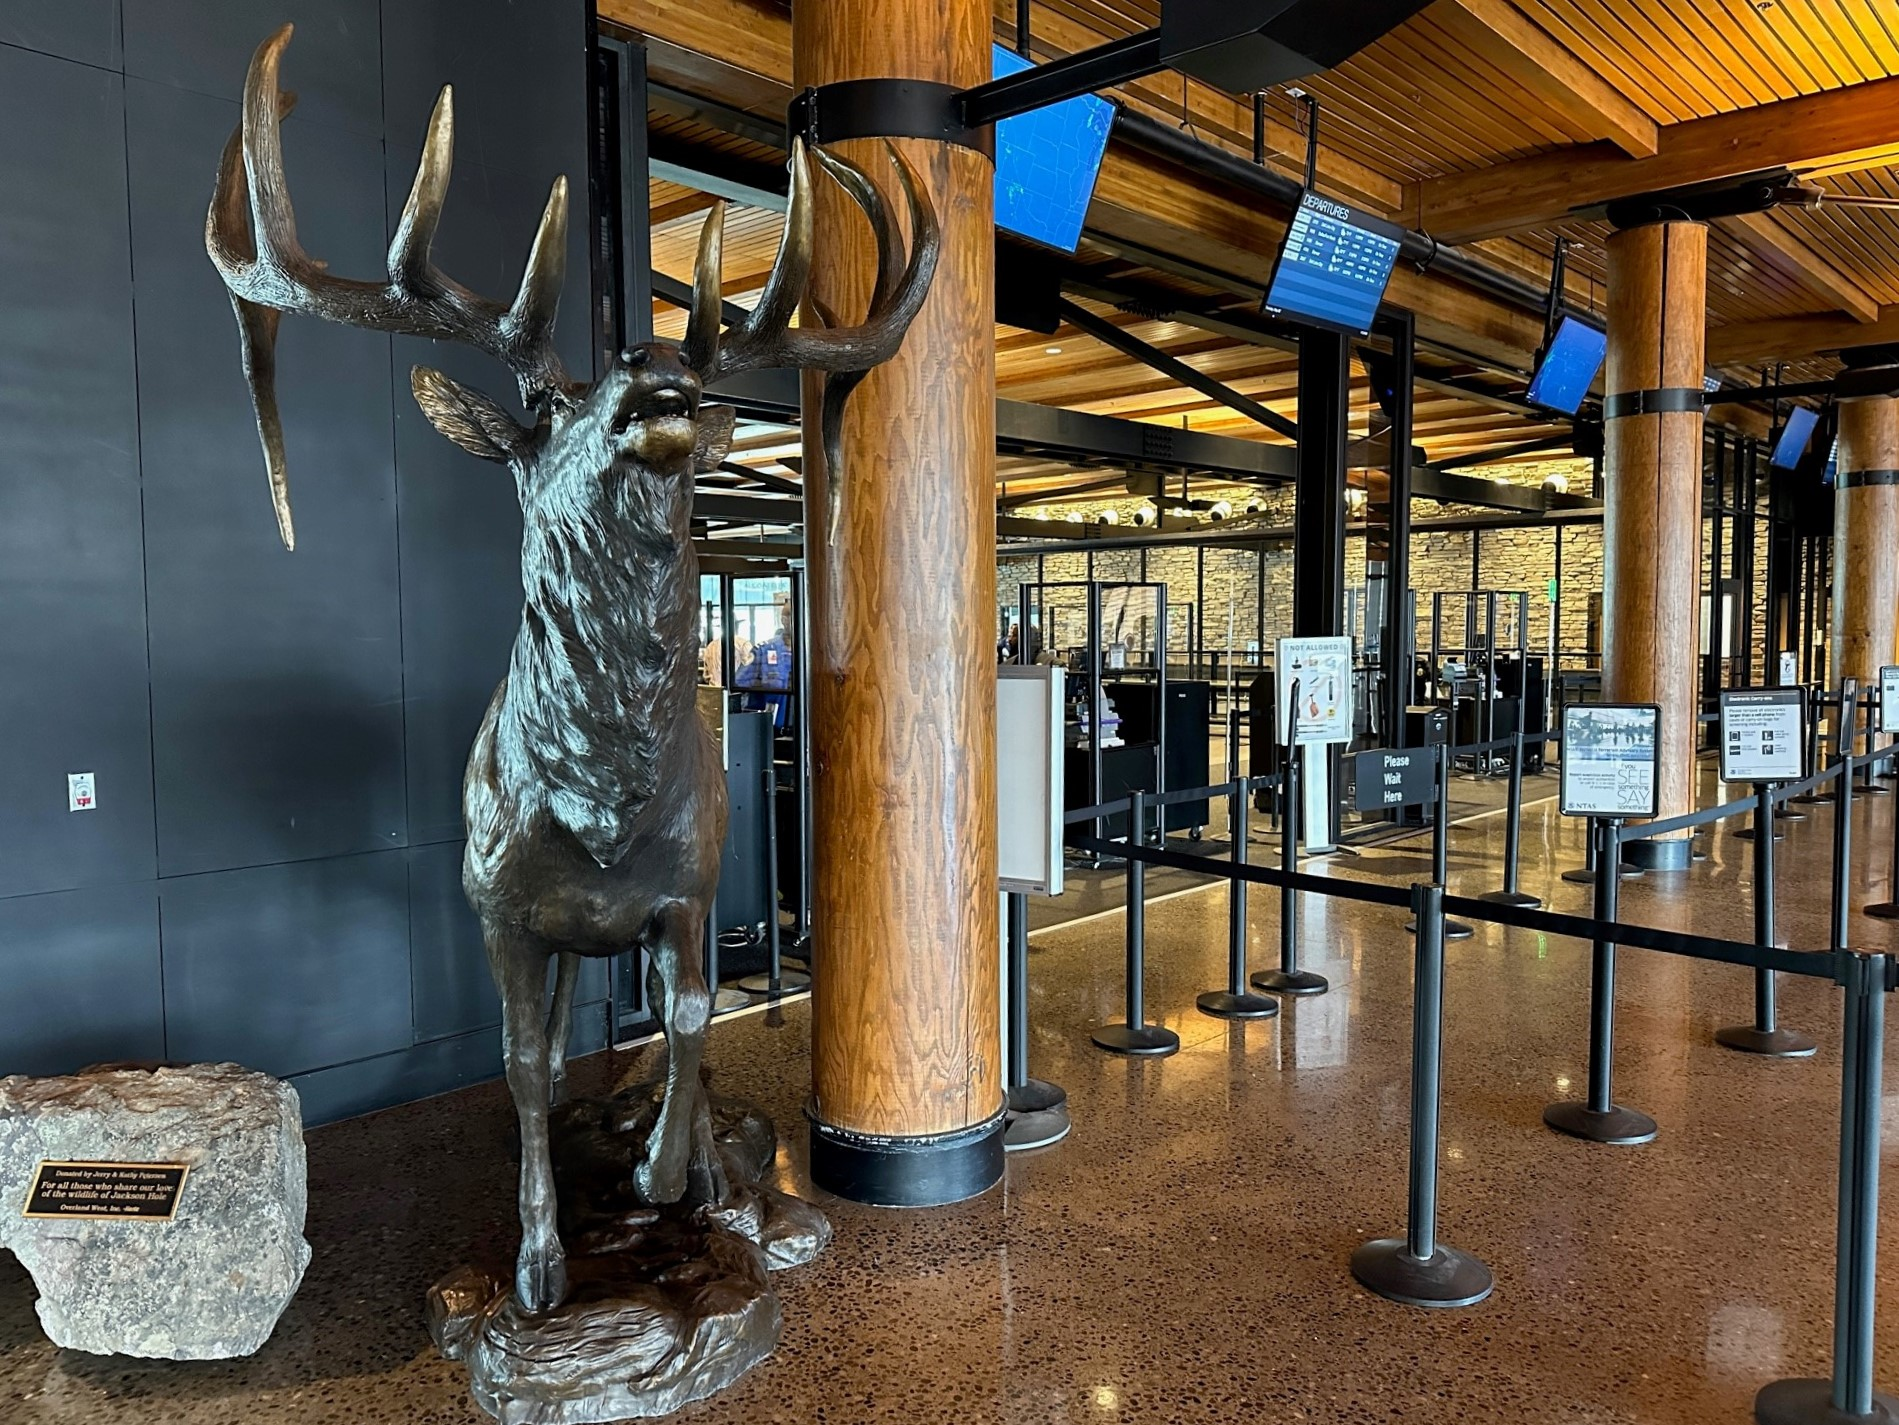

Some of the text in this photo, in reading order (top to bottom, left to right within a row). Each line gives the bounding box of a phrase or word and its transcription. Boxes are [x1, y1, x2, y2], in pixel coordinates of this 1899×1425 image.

[1303, 194, 1350, 220] DEPARTURES
[1384, 755, 1410, 768] Please
[1384, 772, 1402, 786] Wait
[1617, 769, 1649, 784] SEE
[1384, 790, 1403, 803] Here
[1617, 790, 1650, 805] SAY
[41, 1181, 56, 1189] For
[70, 1182, 93, 1190] those
[95, 1182, 113, 1190] who
[114, 1183, 138, 1191] share
[156, 1184, 174, 1192] love
[41, 1190, 167, 1200] of the wildlife of Jackson Hole
